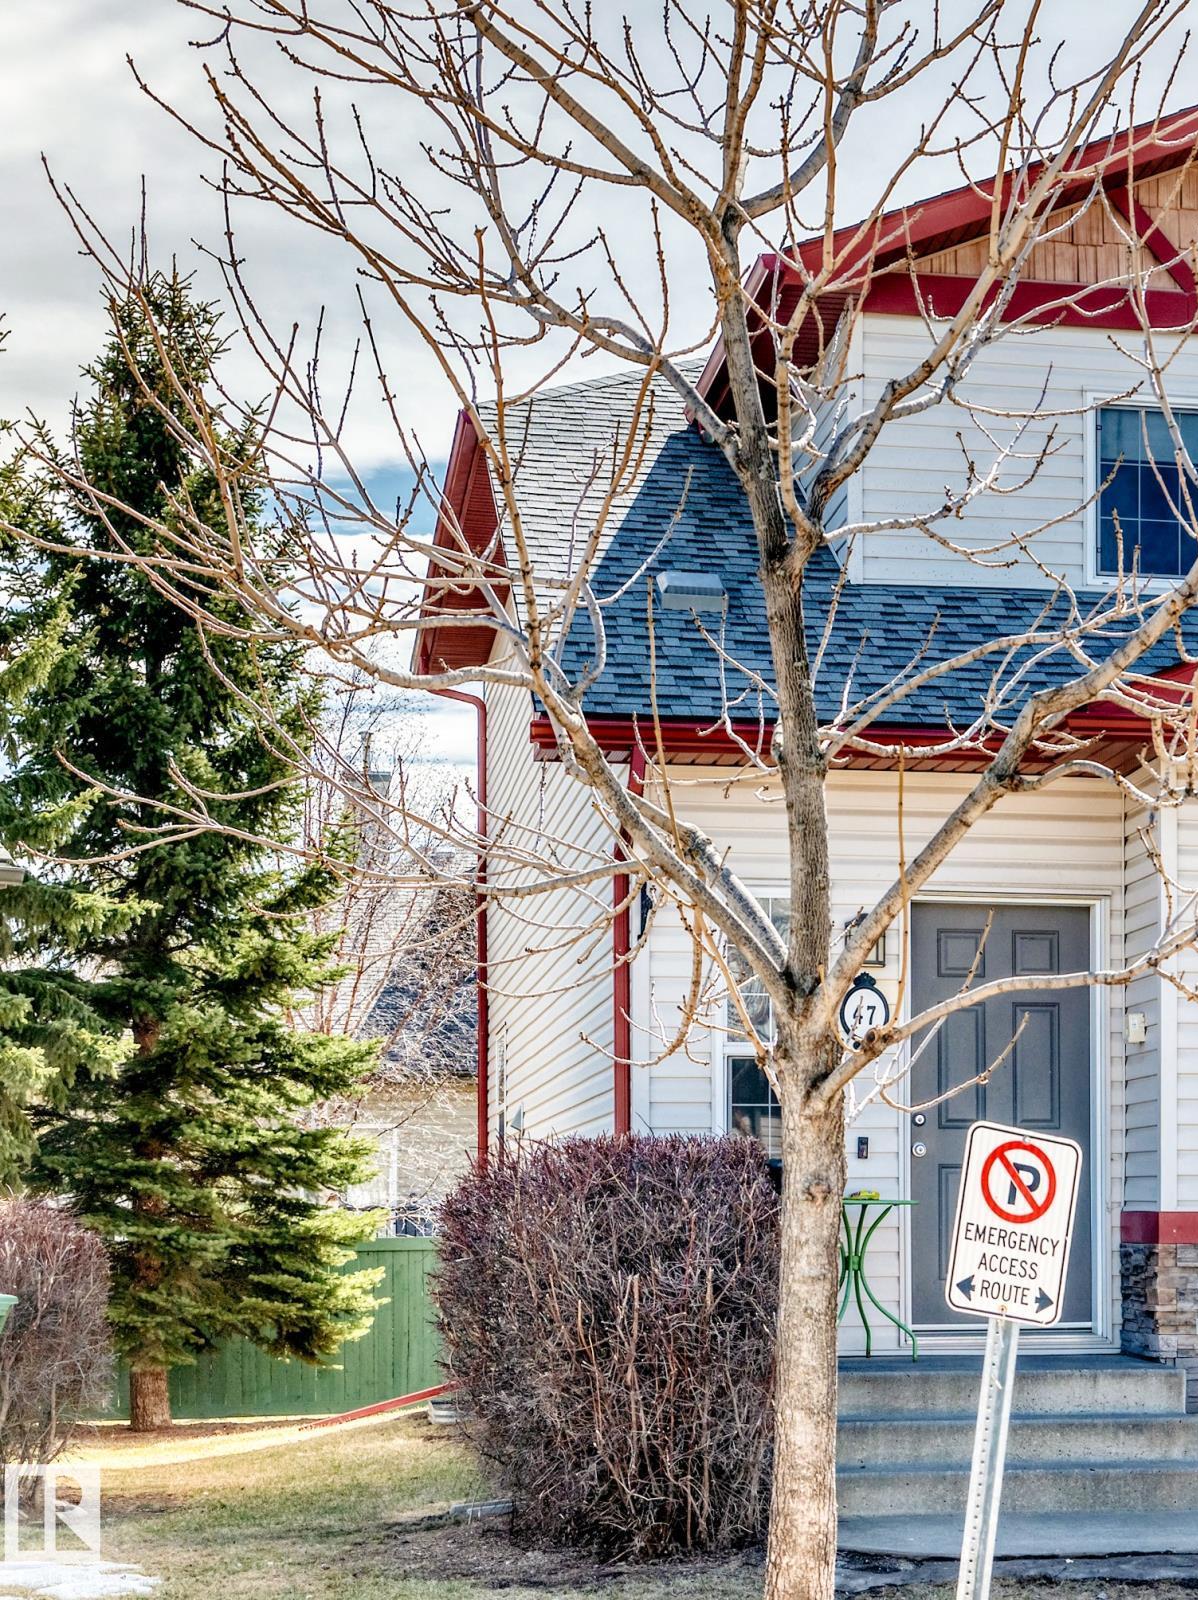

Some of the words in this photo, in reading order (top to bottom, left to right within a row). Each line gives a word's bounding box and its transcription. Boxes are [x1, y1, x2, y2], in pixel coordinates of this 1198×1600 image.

[853, 1005, 876, 1025] 47
[964, 1222, 1060, 1257] EMERGENCY
[977, 1252, 1038, 1280] ACCESS
[980, 1279, 1030, 1306] ROUTE
